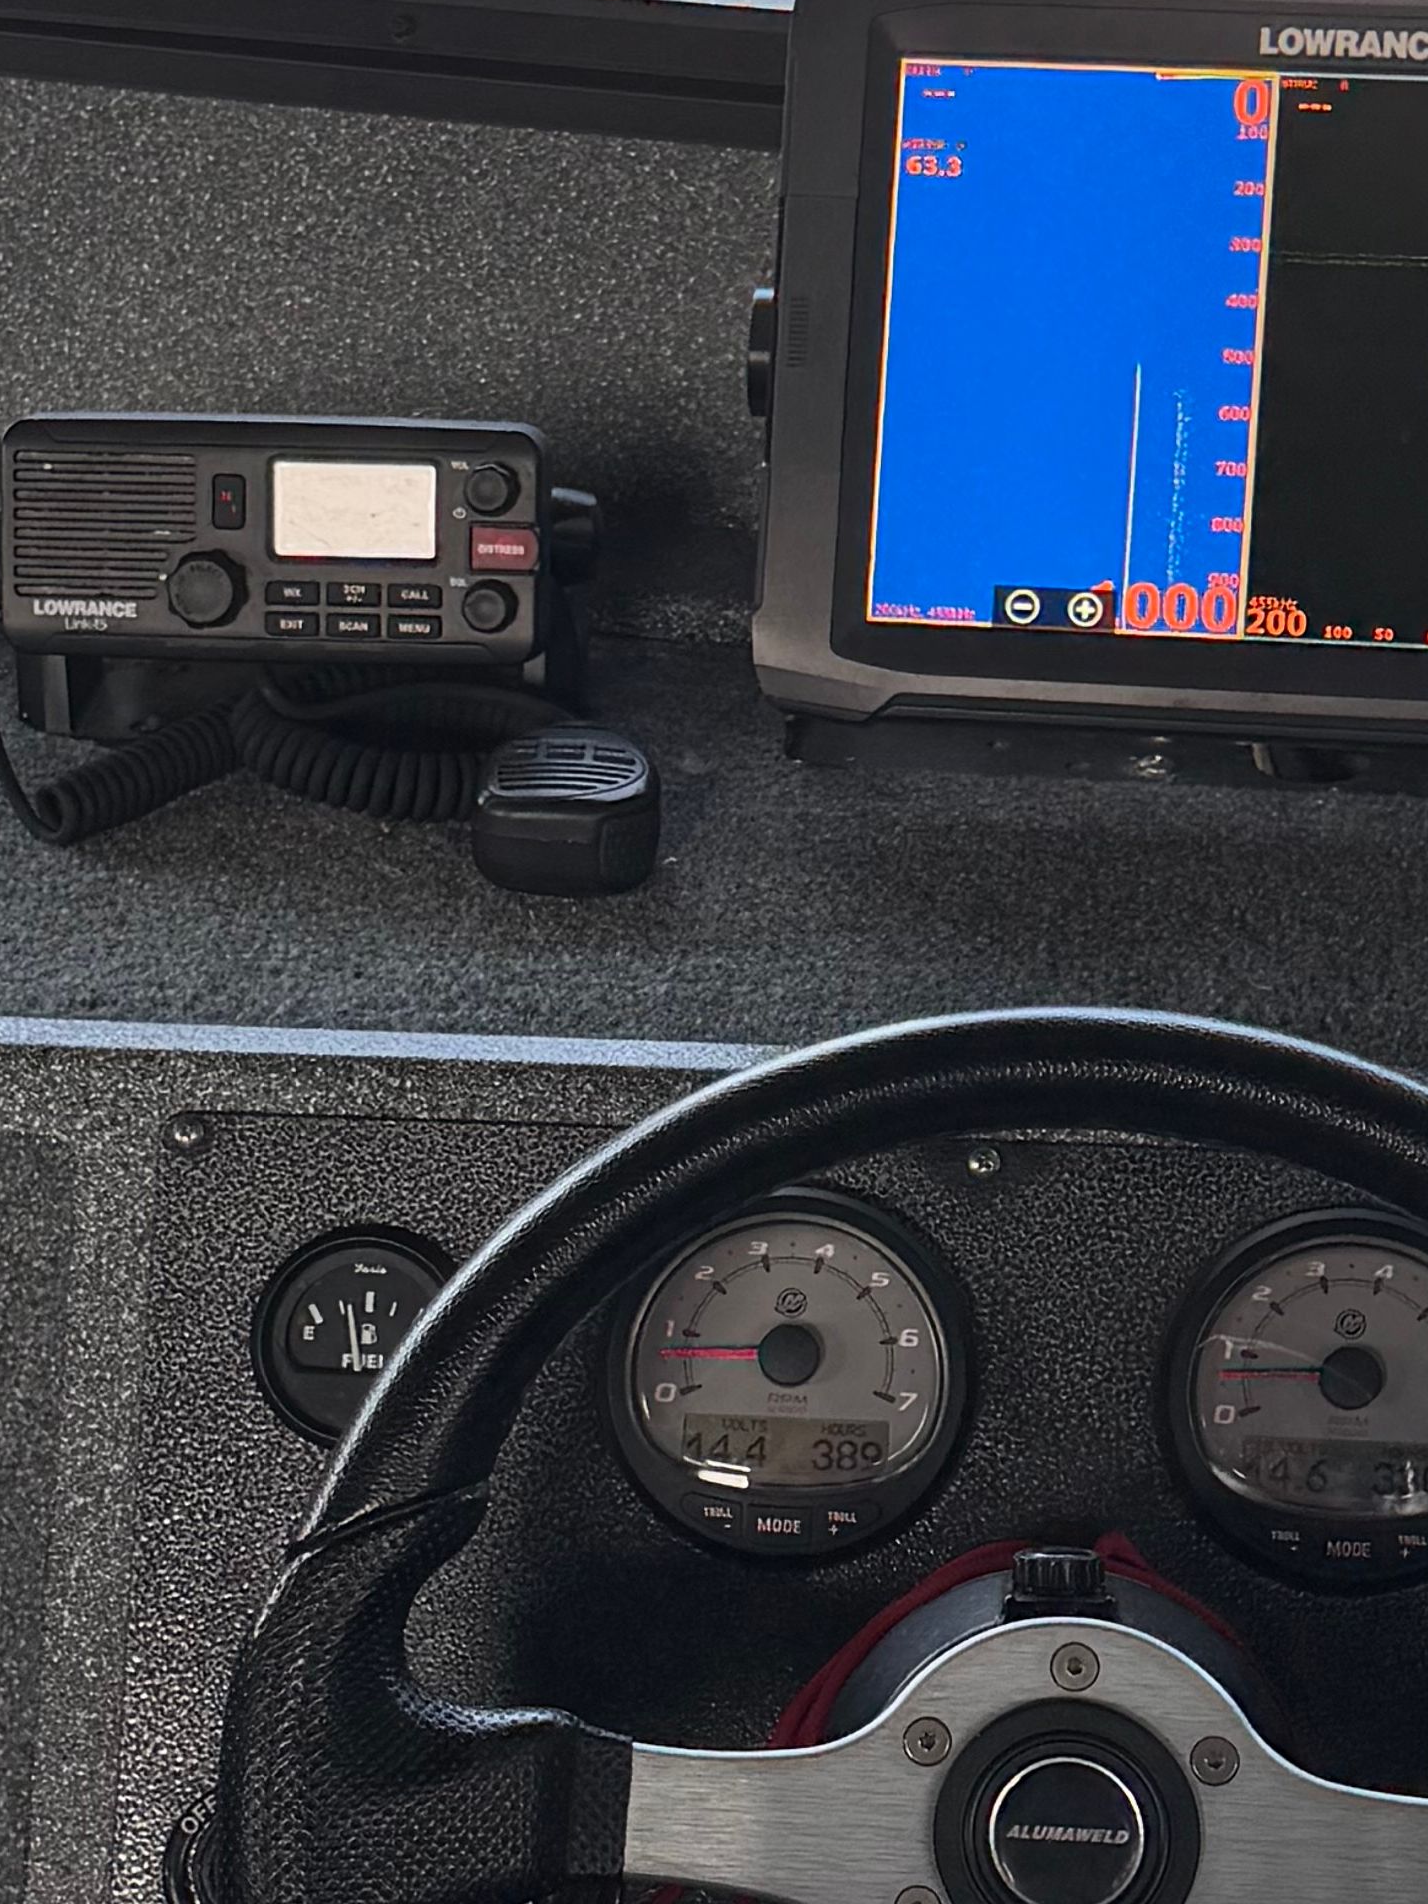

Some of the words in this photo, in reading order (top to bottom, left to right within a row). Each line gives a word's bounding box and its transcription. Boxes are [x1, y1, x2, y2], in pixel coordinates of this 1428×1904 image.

[1234, 79, 1270, 125] 0
[905, 156, 963, 177] 63.3
[1233, 181, 1266, 197] 200
[1229, 237, 1262, 253] 300
[1225, 294, 1258, 309] 400
[1218, 406, 1251, 421] 600
[1214, 460, 1247, 477] 700
[33, 599, 138, 618] LOWRANCE
[1246, 609, 1308, 638] 200
[1323, 625, 1353, 640] 100
[1374, 628, 1394, 643] 50
[748, 1241, 768, 1256] 3
[816, 1244, 835, 1258] 4
[694, 1266, 714, 1280] 2
[1305, 1262, 1325, 1276] 3
[1375, 1264, 1394, 1279] 4
[870, 1272, 891, 1288] 5
[1252, 1285, 1272, 1300] 2
[302, 1325, 315, 1340] E
[665, 1319, 674, 1337] 1
[899, 1328, 919, 1347] 6
[1225, 1340, 1233, 1359] 1
[654, 1383, 677, 1402] 0
[898, 1392, 918, 1412] 7
[1213, 1404, 1235, 1424] 0
[812, 1440, 884, 1472] 389
[757, 1517, 801, 1534] MODE
[1326, 1541, 1372, 1558] MODE
[181, 1794, 217, 1834] OFF
[1006, 1825, 1129, 1845] ALUMAWELD
